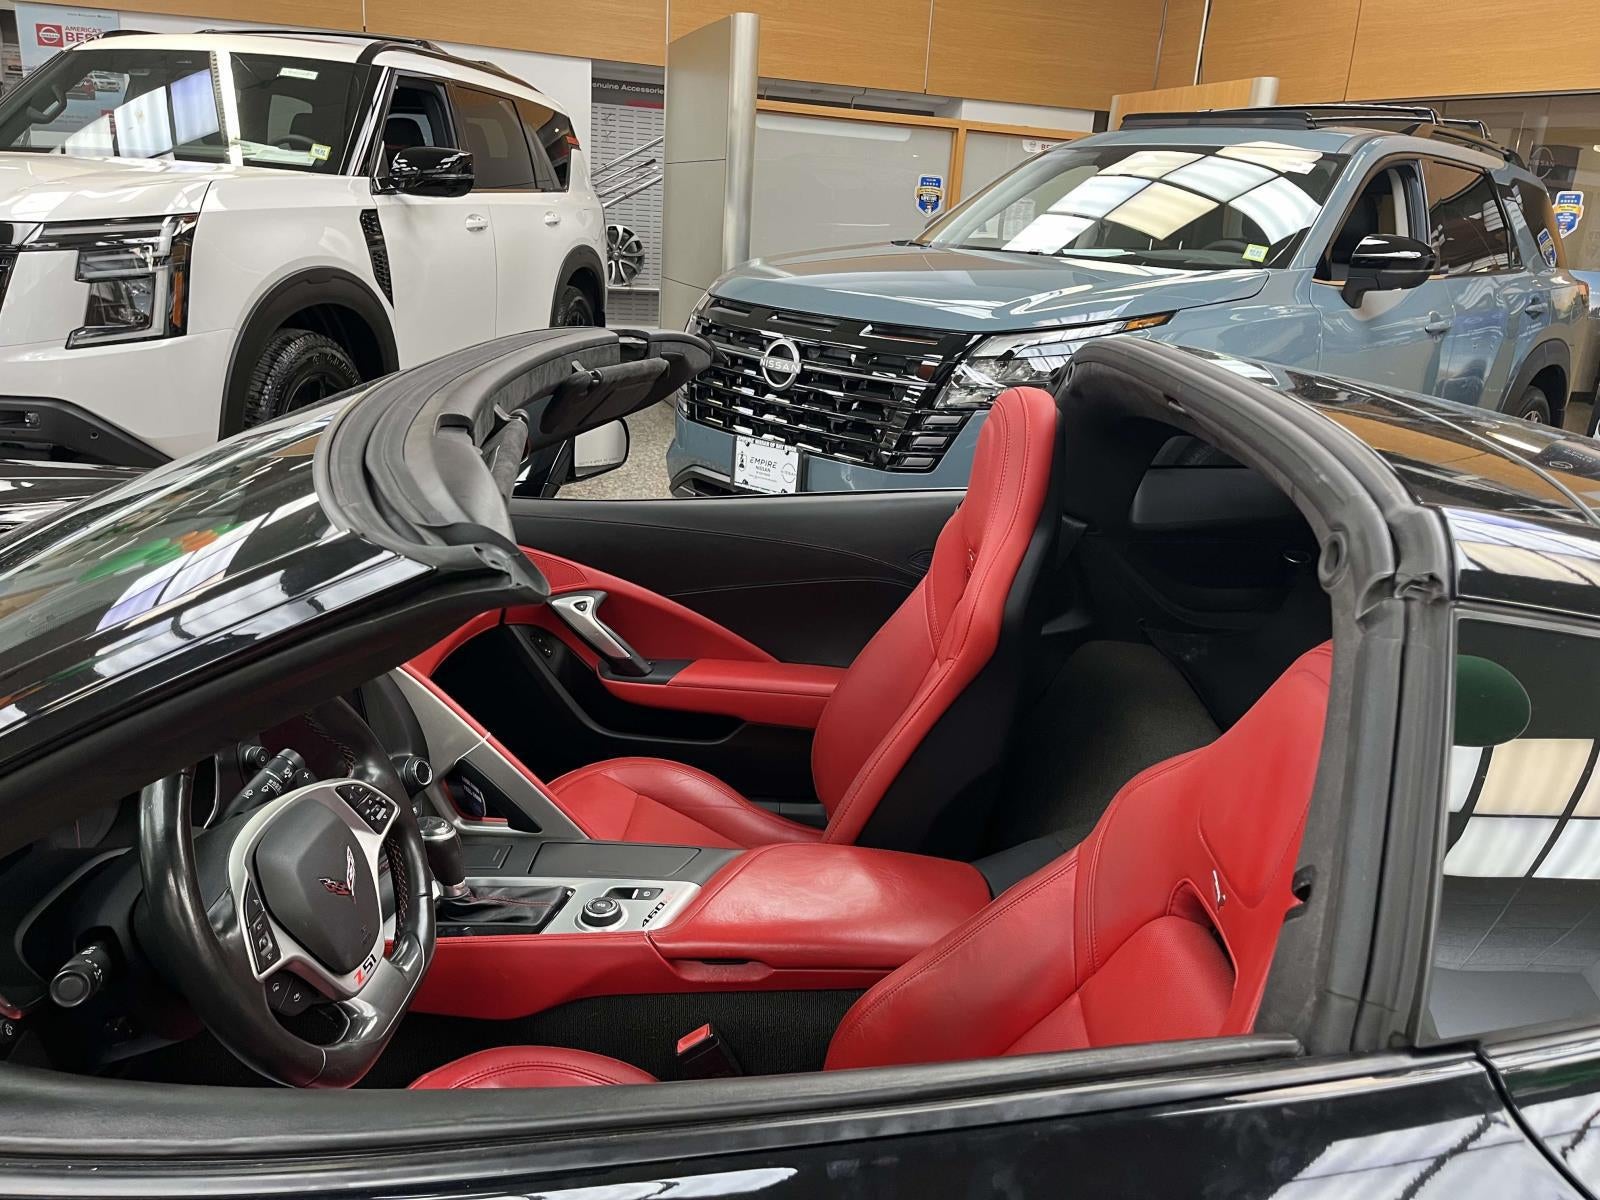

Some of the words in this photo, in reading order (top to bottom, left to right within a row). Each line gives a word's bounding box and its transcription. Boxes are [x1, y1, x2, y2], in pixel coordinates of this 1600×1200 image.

[592, 82, 620, 90] enuine
[621, 84, 664, 94] Accessorie
[760, 358, 801, 374] NISSAN
[750, 457, 778, 469] EMPIRE
[353, 953, 377, 985] Z51
